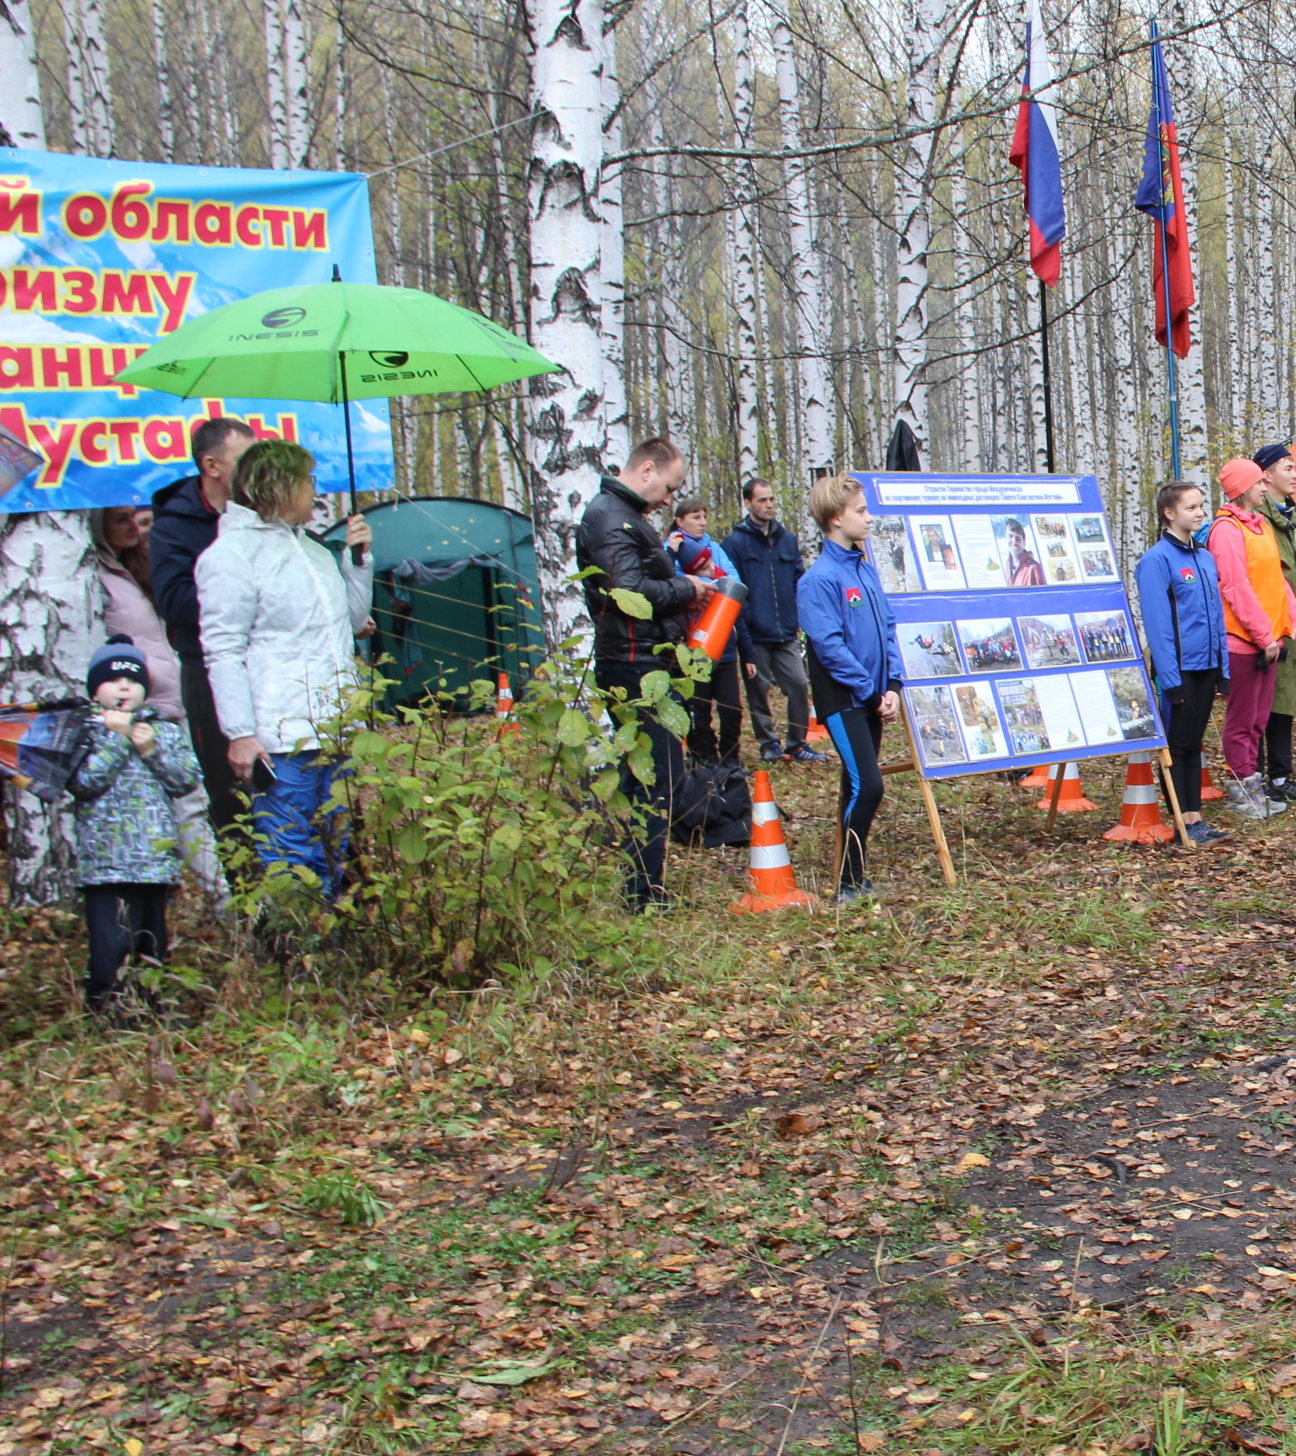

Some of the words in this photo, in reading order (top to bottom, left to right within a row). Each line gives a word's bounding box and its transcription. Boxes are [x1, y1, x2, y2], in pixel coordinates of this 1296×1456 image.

[63, 182, 328, 250] области
[0, 268, 194, 333] изму
[229, 330, 320, 342] INESIS
[0, 345, 151, 396] анц
[110, 660, 141, 673] UFC
